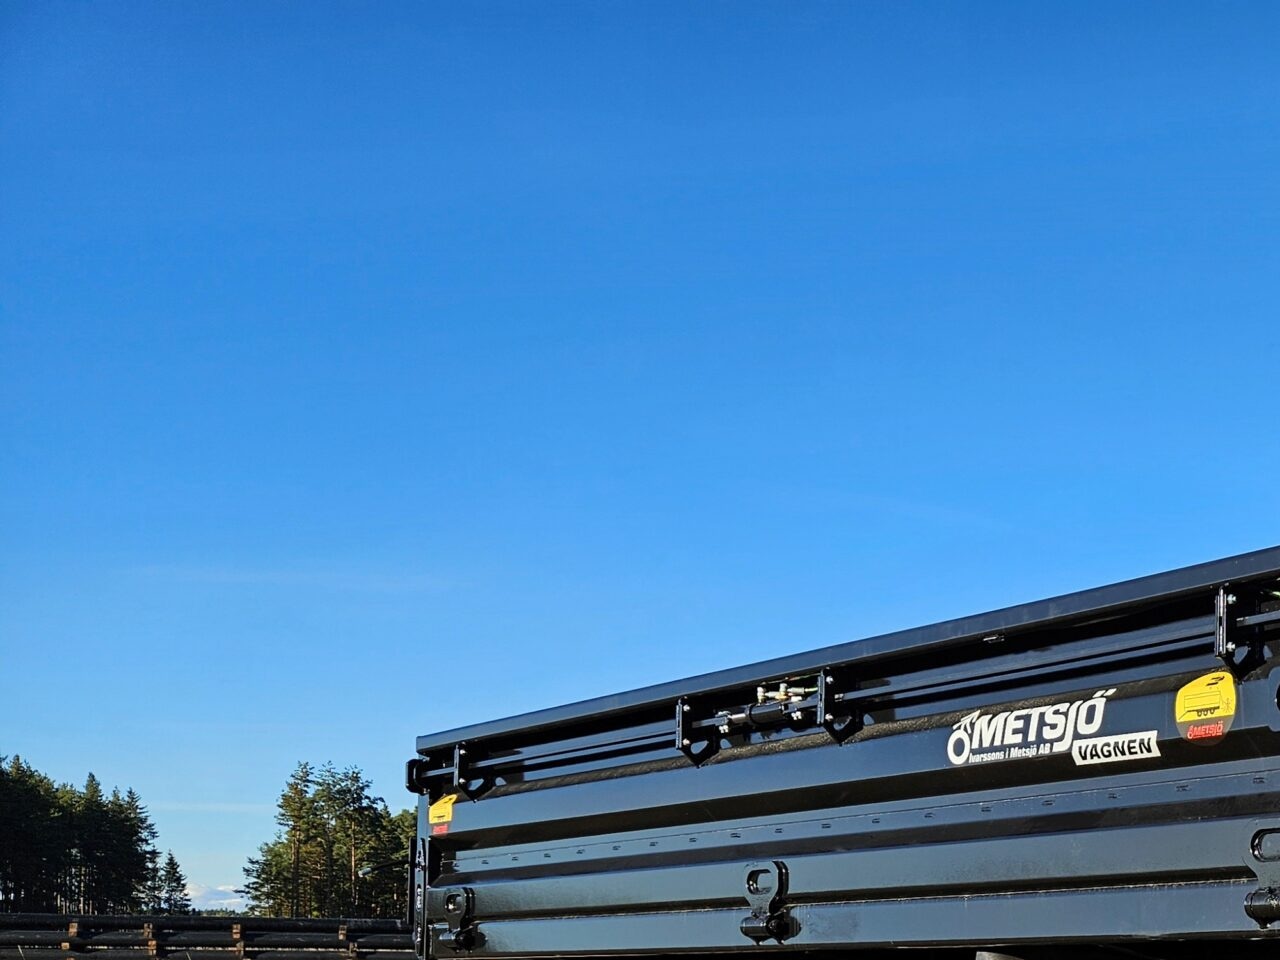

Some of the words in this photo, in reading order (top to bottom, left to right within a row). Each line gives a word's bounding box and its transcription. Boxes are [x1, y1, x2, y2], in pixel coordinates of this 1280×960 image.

[971, 688, 1117, 753] METSJÖ
[968, 750, 1005, 764] Ivarssons
[1010, 744, 1037, 758] Metsjö
[1038, 742, 1051, 755] AB
[1078, 737, 1152, 761] VAGNEN
